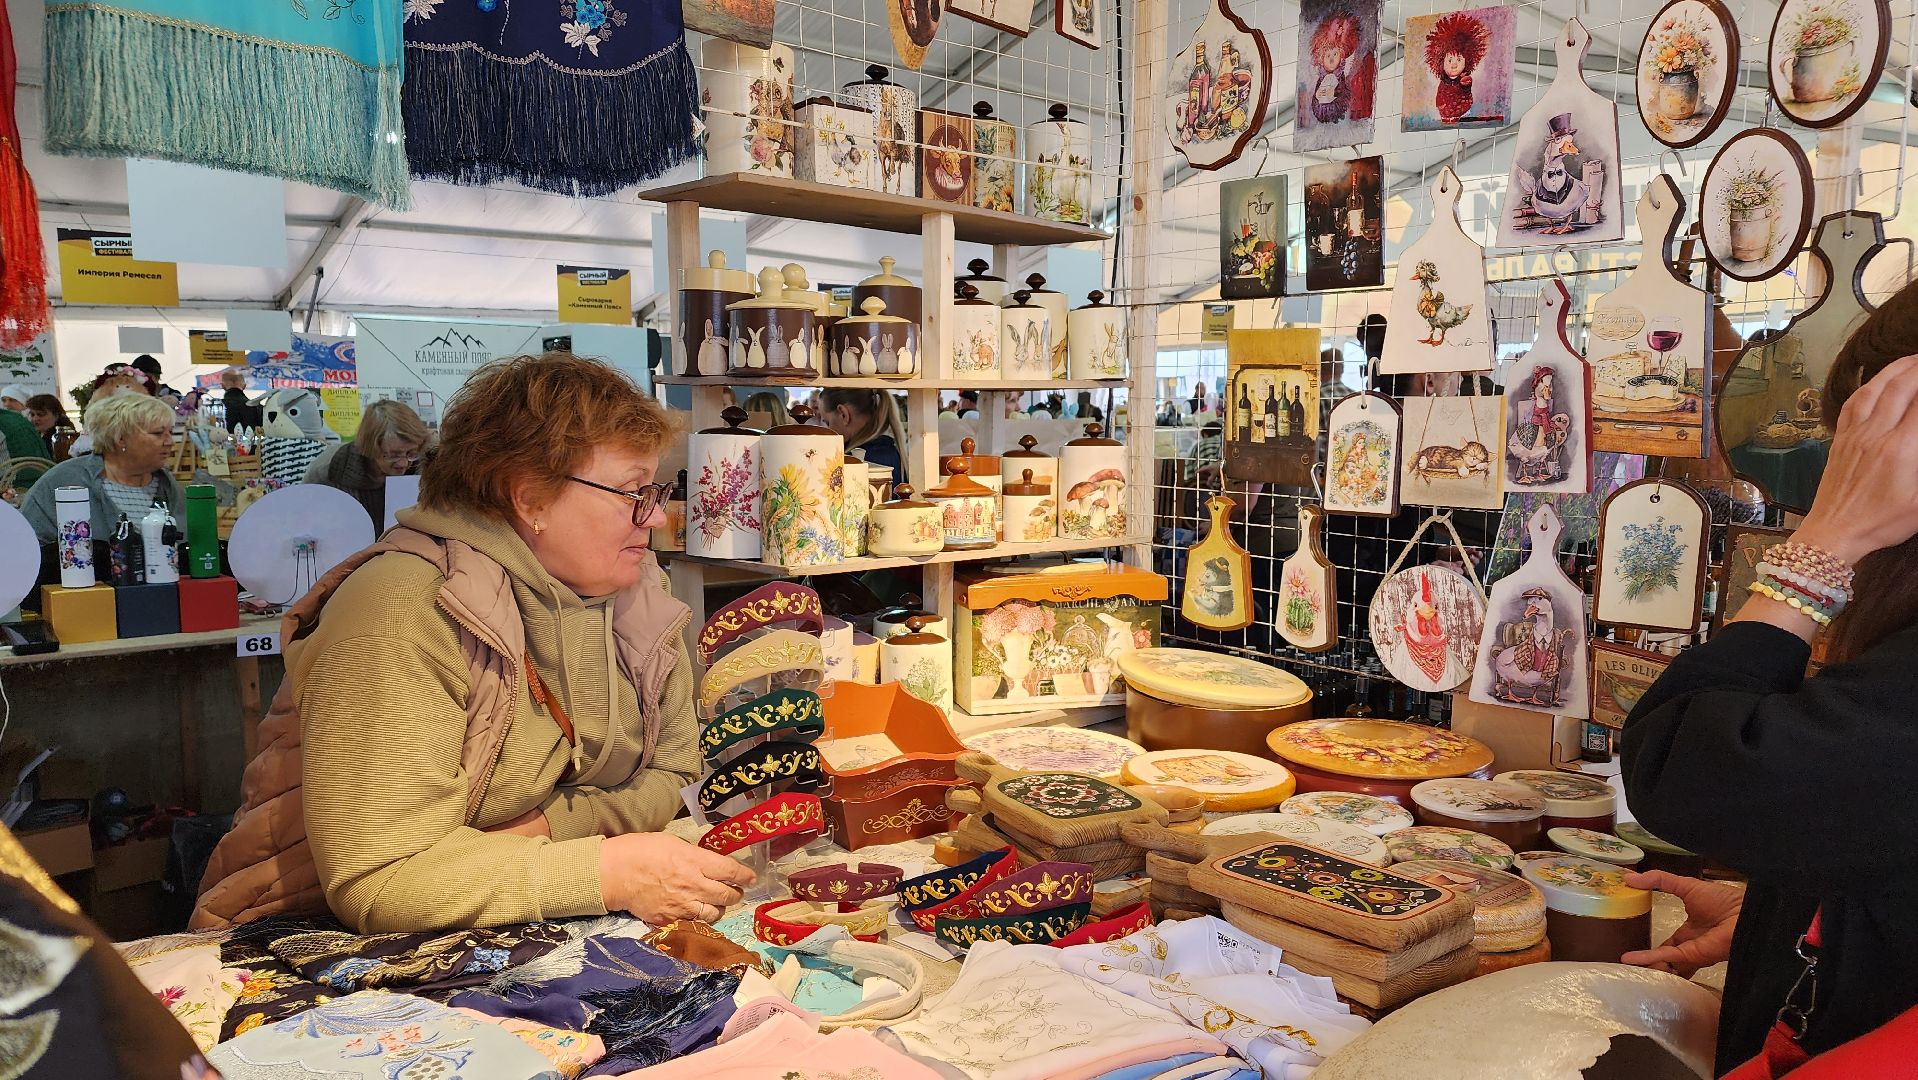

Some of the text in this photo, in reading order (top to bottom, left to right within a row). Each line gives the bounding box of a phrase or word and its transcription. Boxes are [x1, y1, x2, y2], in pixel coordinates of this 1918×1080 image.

[78, 268, 162, 280] Империя Ремесел
[415, 350, 468, 364] КАМЕННЫЙ
[245, 637, 272, 652] 68
[1605, 660, 1626, 671] LES
